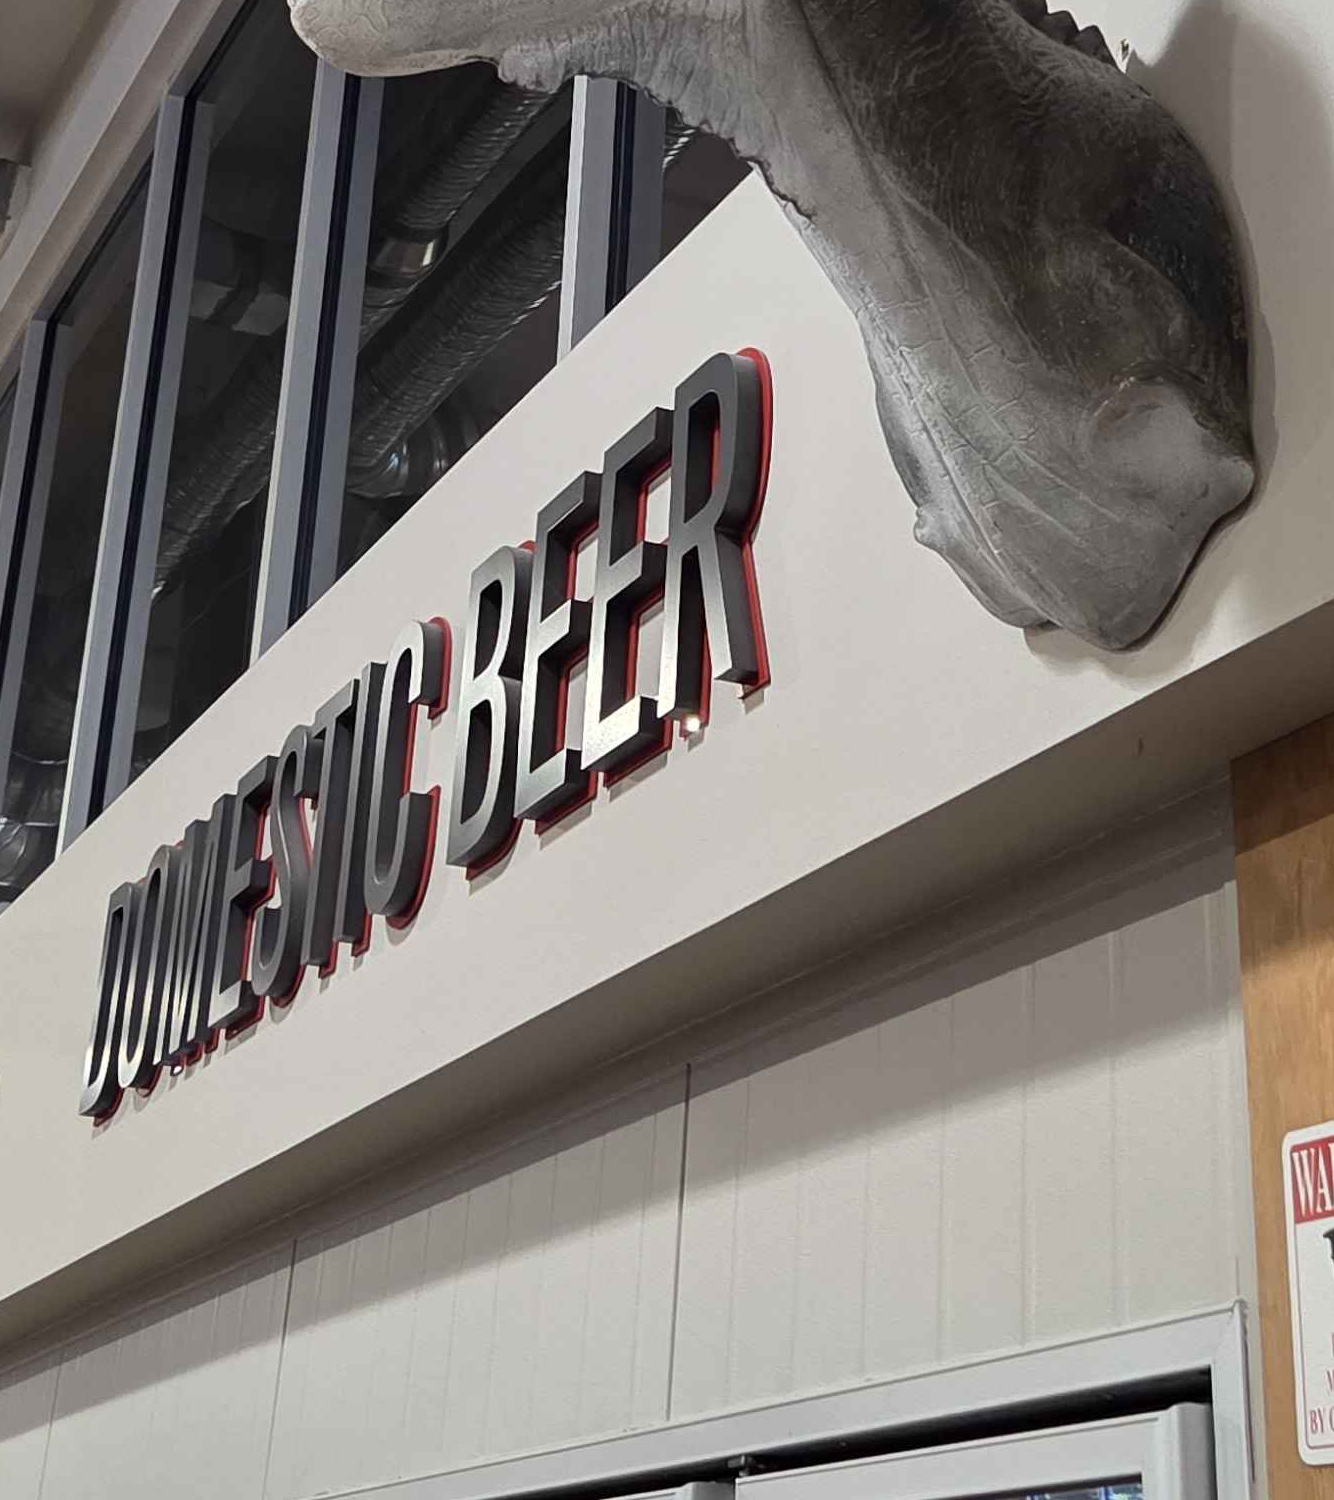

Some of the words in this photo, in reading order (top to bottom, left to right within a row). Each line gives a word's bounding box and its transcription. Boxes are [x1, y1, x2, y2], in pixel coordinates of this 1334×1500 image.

[79, 616, 452, 1127] DOMESTIC
[446, 347, 774, 880] BEER
[1309, 1408, 1326, 1434] BY
